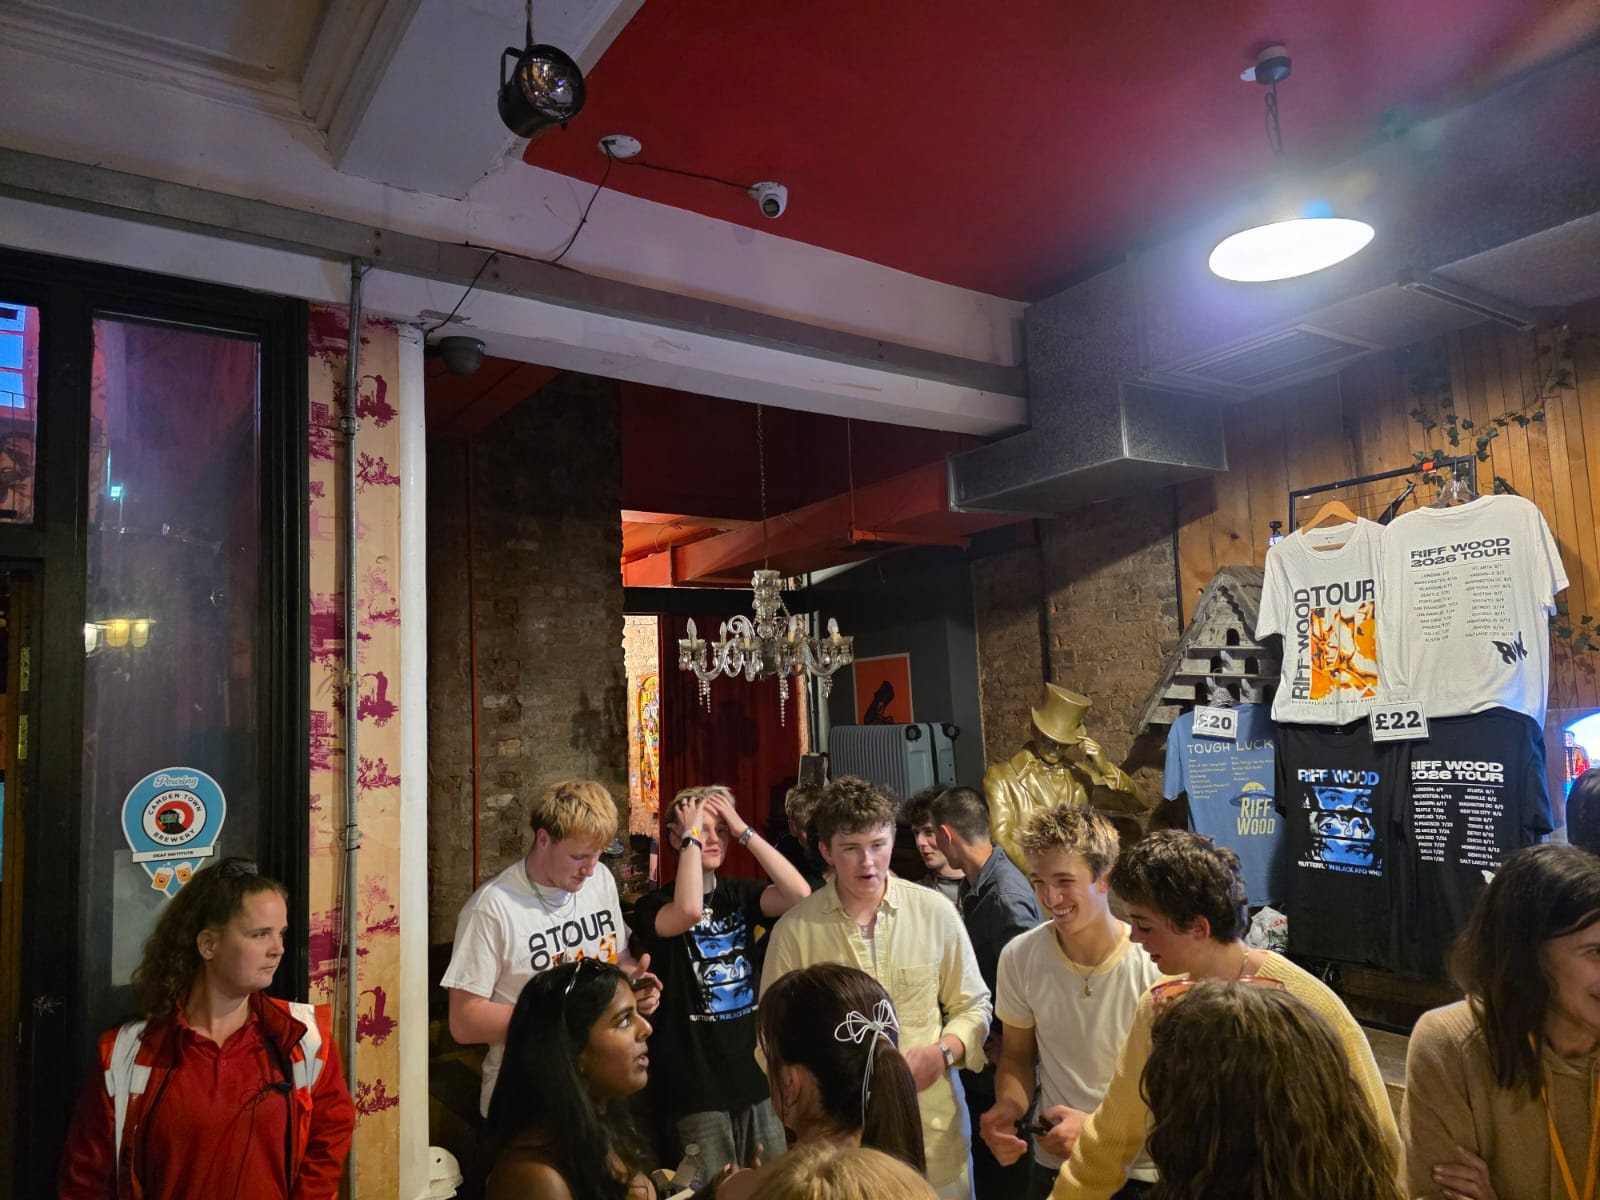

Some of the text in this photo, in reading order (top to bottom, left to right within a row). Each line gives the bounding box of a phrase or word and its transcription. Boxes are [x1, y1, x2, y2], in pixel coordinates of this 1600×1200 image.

[1411, 538, 1510, 559] RIFF WOOD
[1411, 547, 1511, 568] 2026 TOUR
[1310, 579, 1375, 607] TOUR
[1294, 588, 1311, 655] WOOD
[1375, 710, 1422, 731] £22
[1186, 739, 1274, 755] TOUGH LUCK
[1297, 768, 1380, 786] RIFF WOOD
[1445, 760, 1504, 773] WOOD
[1455, 770, 1505, 783] TOUR
[154, 774, 198, 789] Pouring
[148, 792, 202, 816] CAMDEN TOWN
[1241, 797, 1273, 818] RIFF
[153, 828, 196, 843] BREWERY
[1237, 817, 1276, 836] WOOD
[545, 909, 616, 953] TOUR
